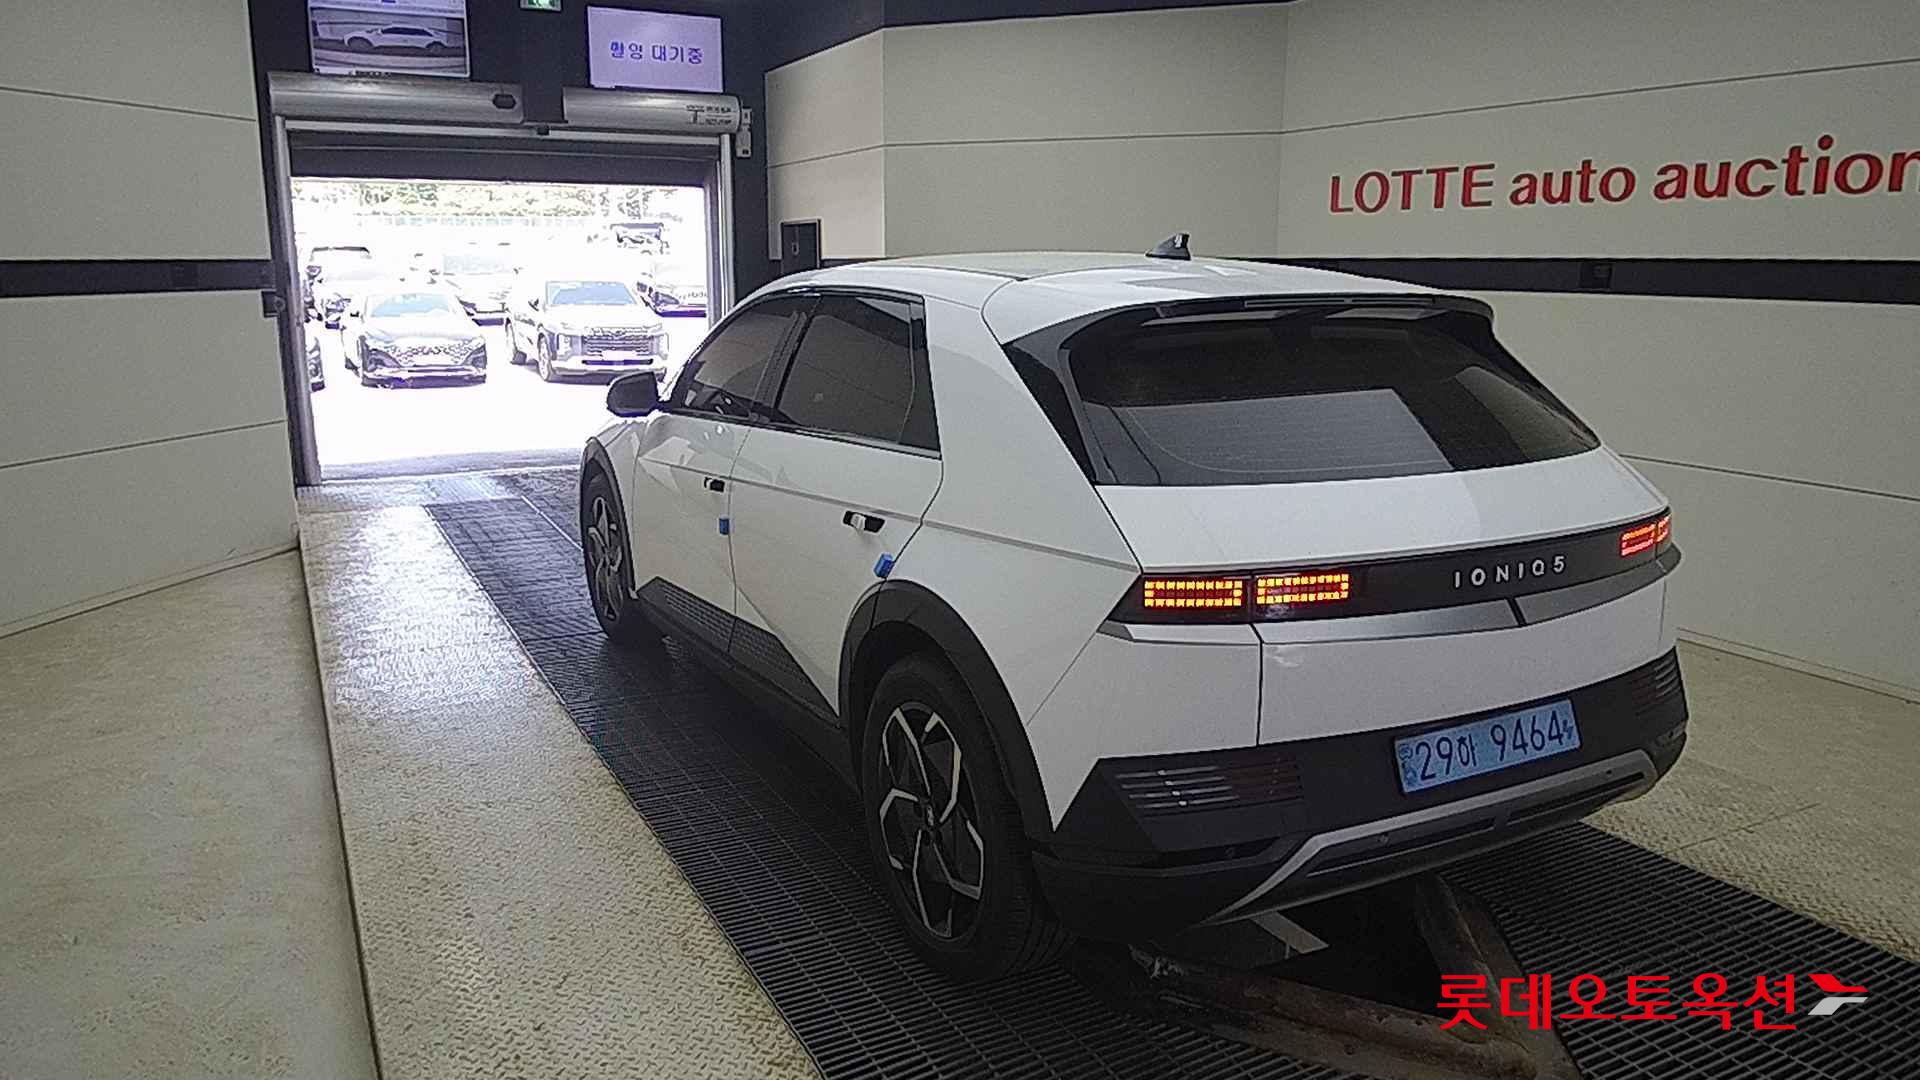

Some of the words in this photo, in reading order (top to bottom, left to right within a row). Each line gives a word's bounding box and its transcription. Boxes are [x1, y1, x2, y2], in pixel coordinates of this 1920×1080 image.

[651, 44, 702, 65] 대기중
[1331, 163, 1495, 213] LOTTE
[1509, 159, 1636, 206] auto
[1653, 134, 1920, 202] auction
[1415, 733, 1477, 781] 29하
[1490, 710, 1563, 762] 9464
